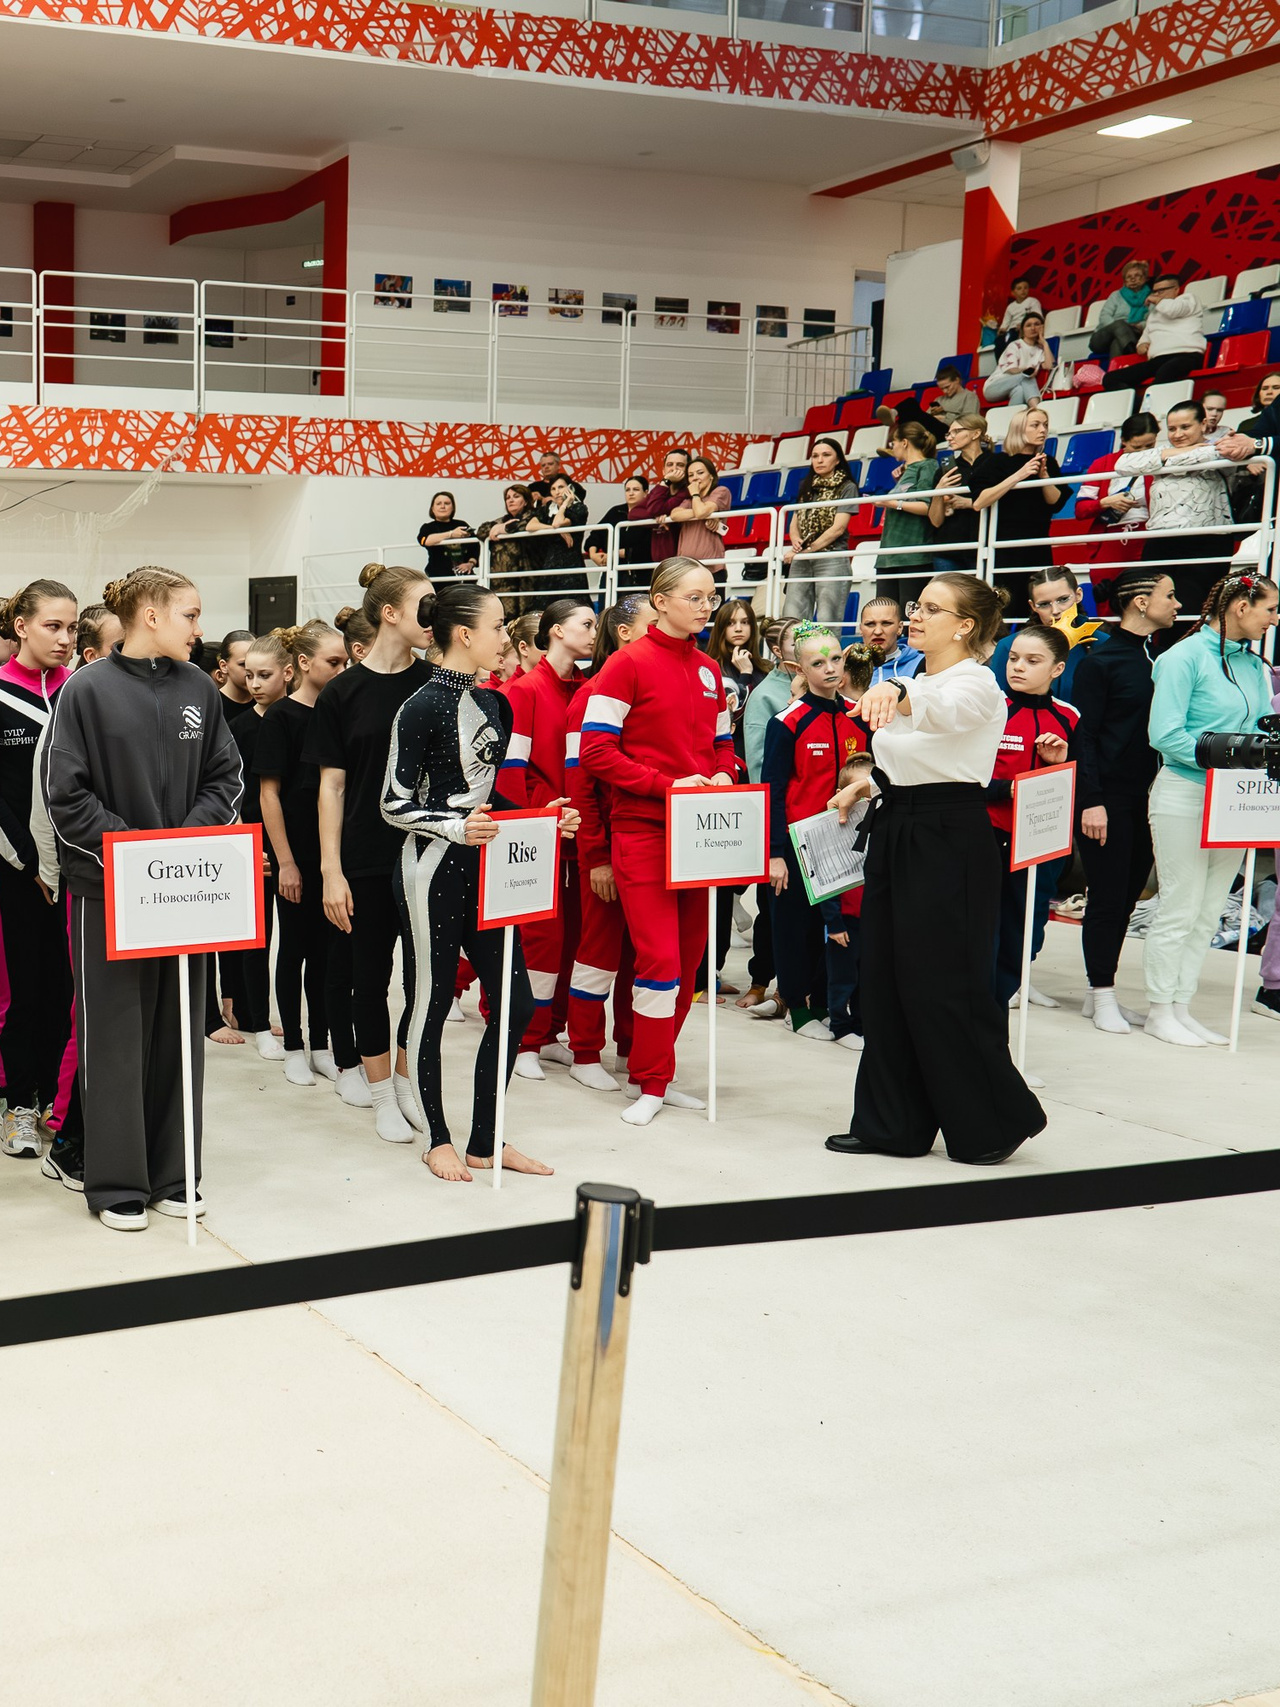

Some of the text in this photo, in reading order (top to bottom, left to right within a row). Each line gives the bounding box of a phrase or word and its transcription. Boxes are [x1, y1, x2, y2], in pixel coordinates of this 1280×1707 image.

[696, 812, 743, 831] MINT
[507, 840, 538, 865] Rise
[695, 838, 743, 849] г. Кемерово
[147, 857, 224, 883] Gravity
[140, 890, 232, 905] г. Новосибирск
